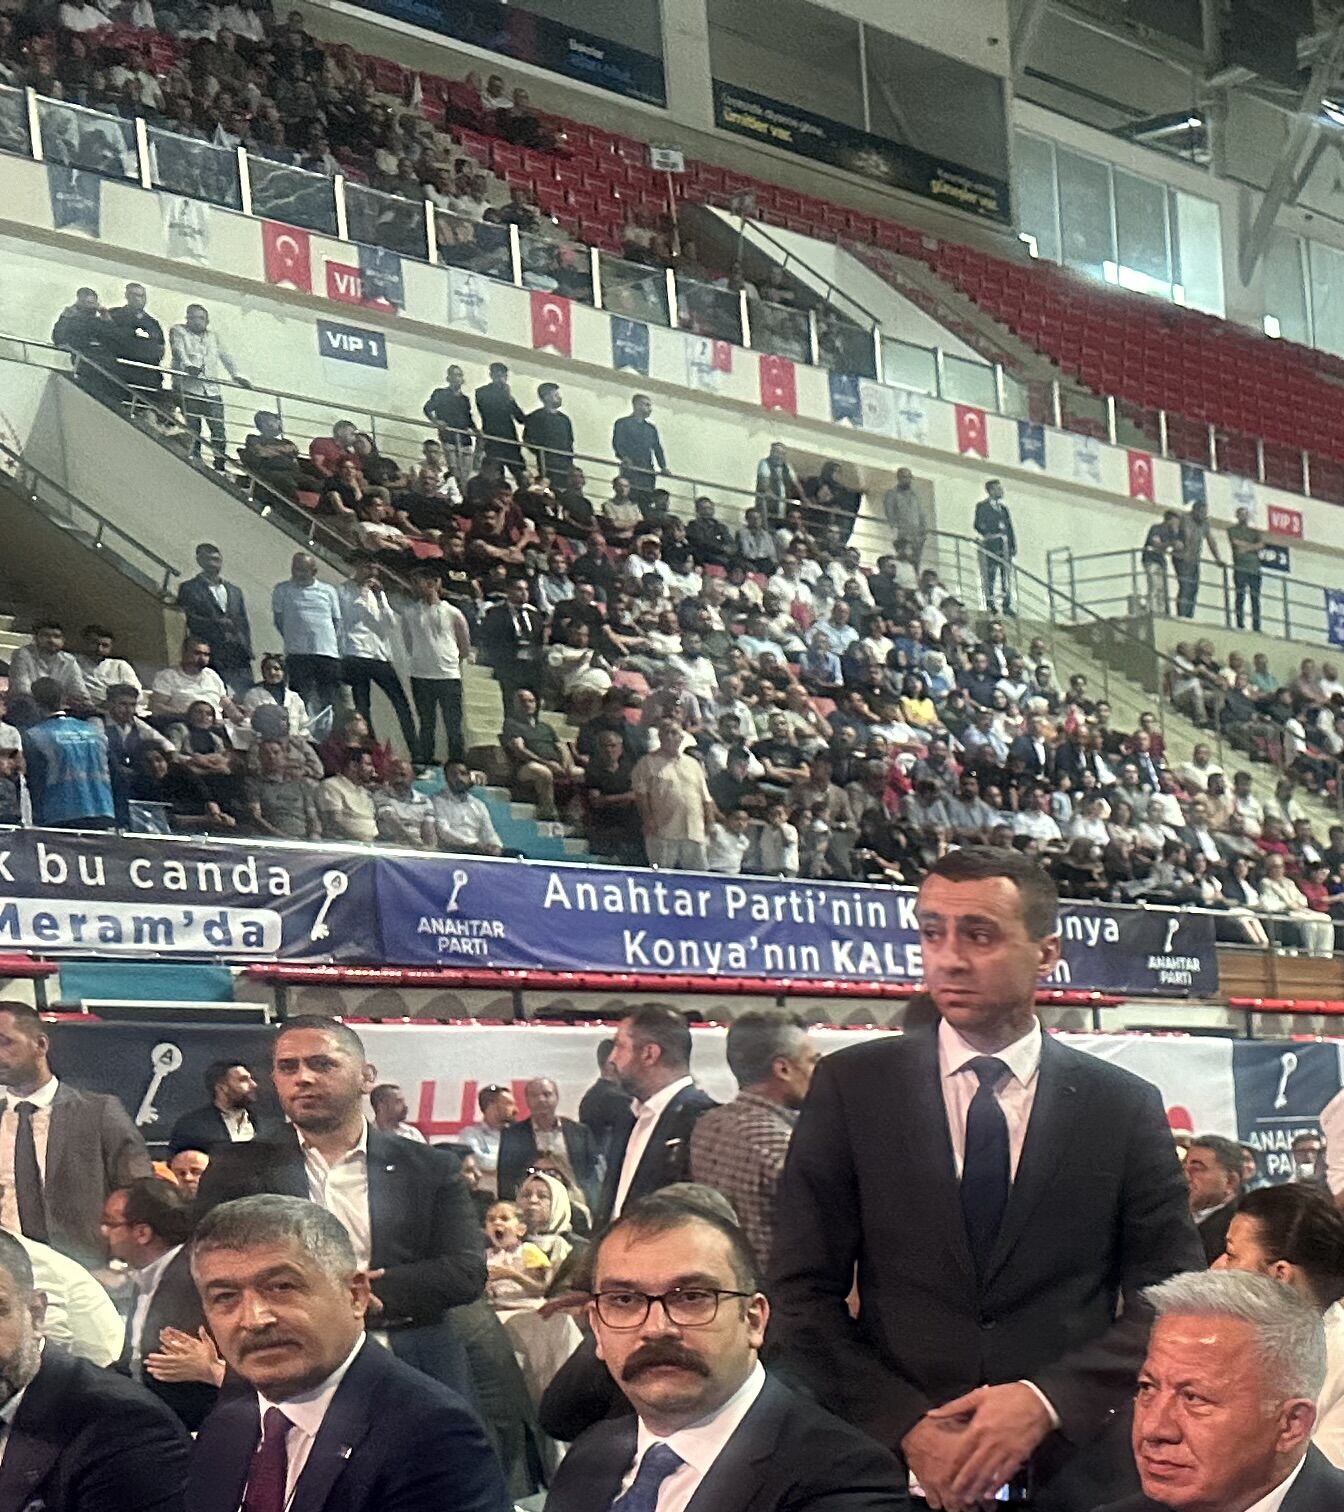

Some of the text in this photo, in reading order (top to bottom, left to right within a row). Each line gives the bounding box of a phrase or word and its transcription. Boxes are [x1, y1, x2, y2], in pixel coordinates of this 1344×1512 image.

[326, 331, 379, 357] VIP 1
[37, 843, 106, 886] bu
[129, 856, 292, 896] canda
[544, 873, 711, 917] Anahtar
[725, 884, 887, 929] Parti'nin
[417, 917, 505, 938] ANAHTAR
[623, 930, 820, 972] Konya'nın
[1148, 956, 1201, 971] ANAHTAR
